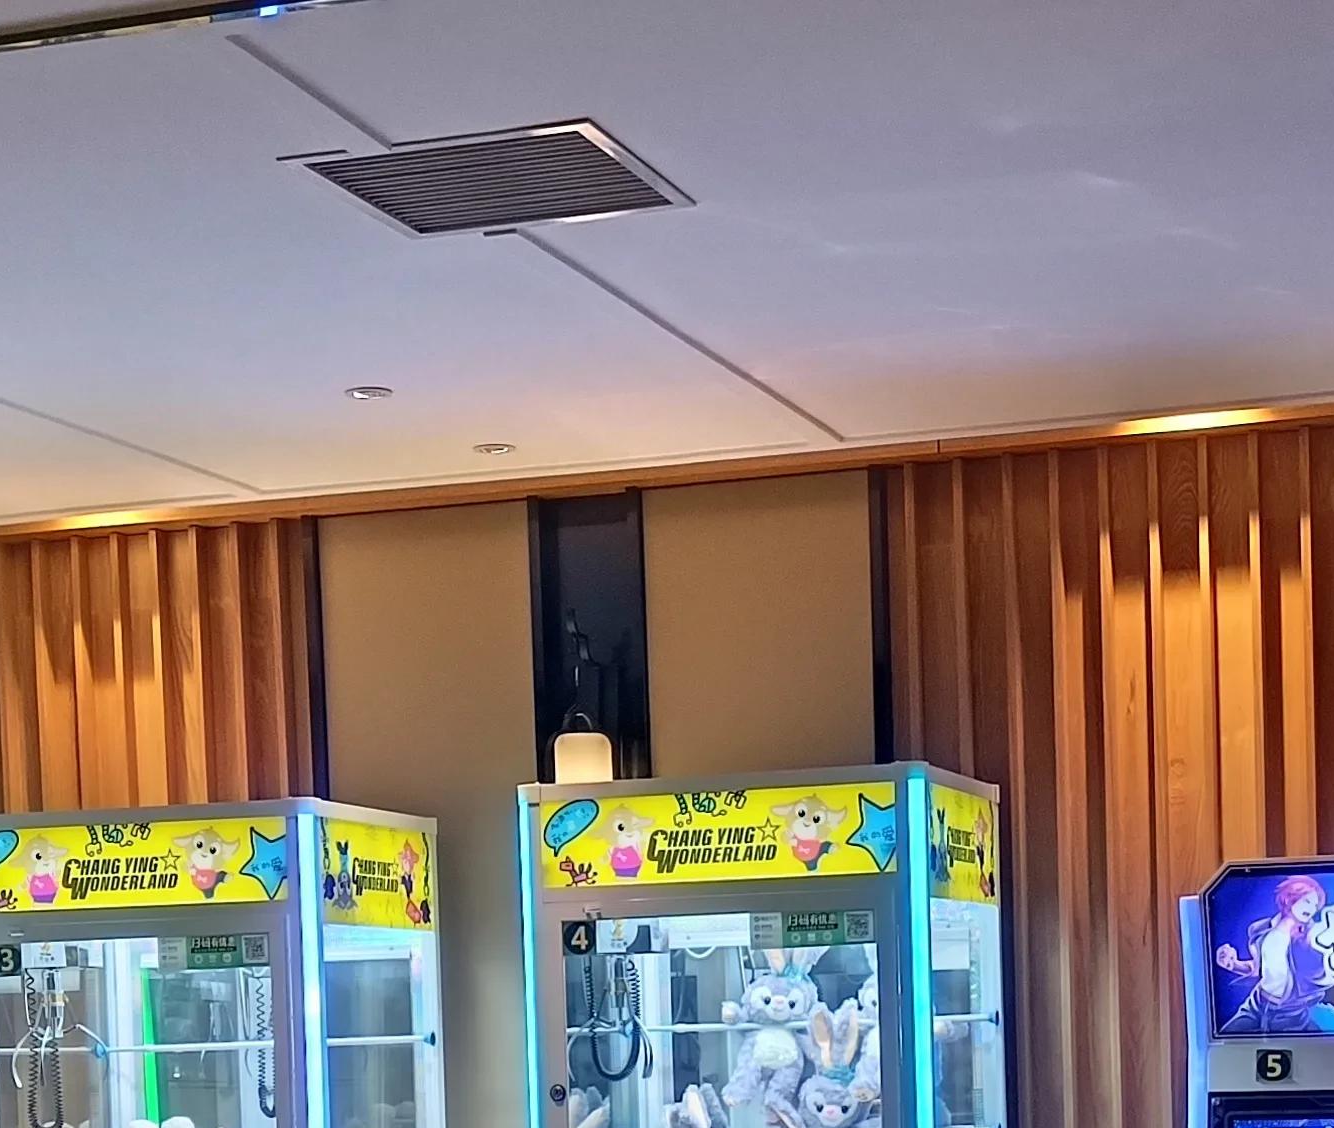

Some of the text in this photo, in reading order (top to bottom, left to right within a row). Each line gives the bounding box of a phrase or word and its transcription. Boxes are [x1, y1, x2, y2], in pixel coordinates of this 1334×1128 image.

[647, 827, 755, 861] CHANG YING
[62, 857, 159, 888] CHANG YING
[657, 845, 777, 873] WONDERLAND
[71, 873, 178, 900] WONDERLAND
[571, 926, 588, 950] 4
[0, 949, 13, 972] 3
[1267, 1054, 1282, 1077] 5
